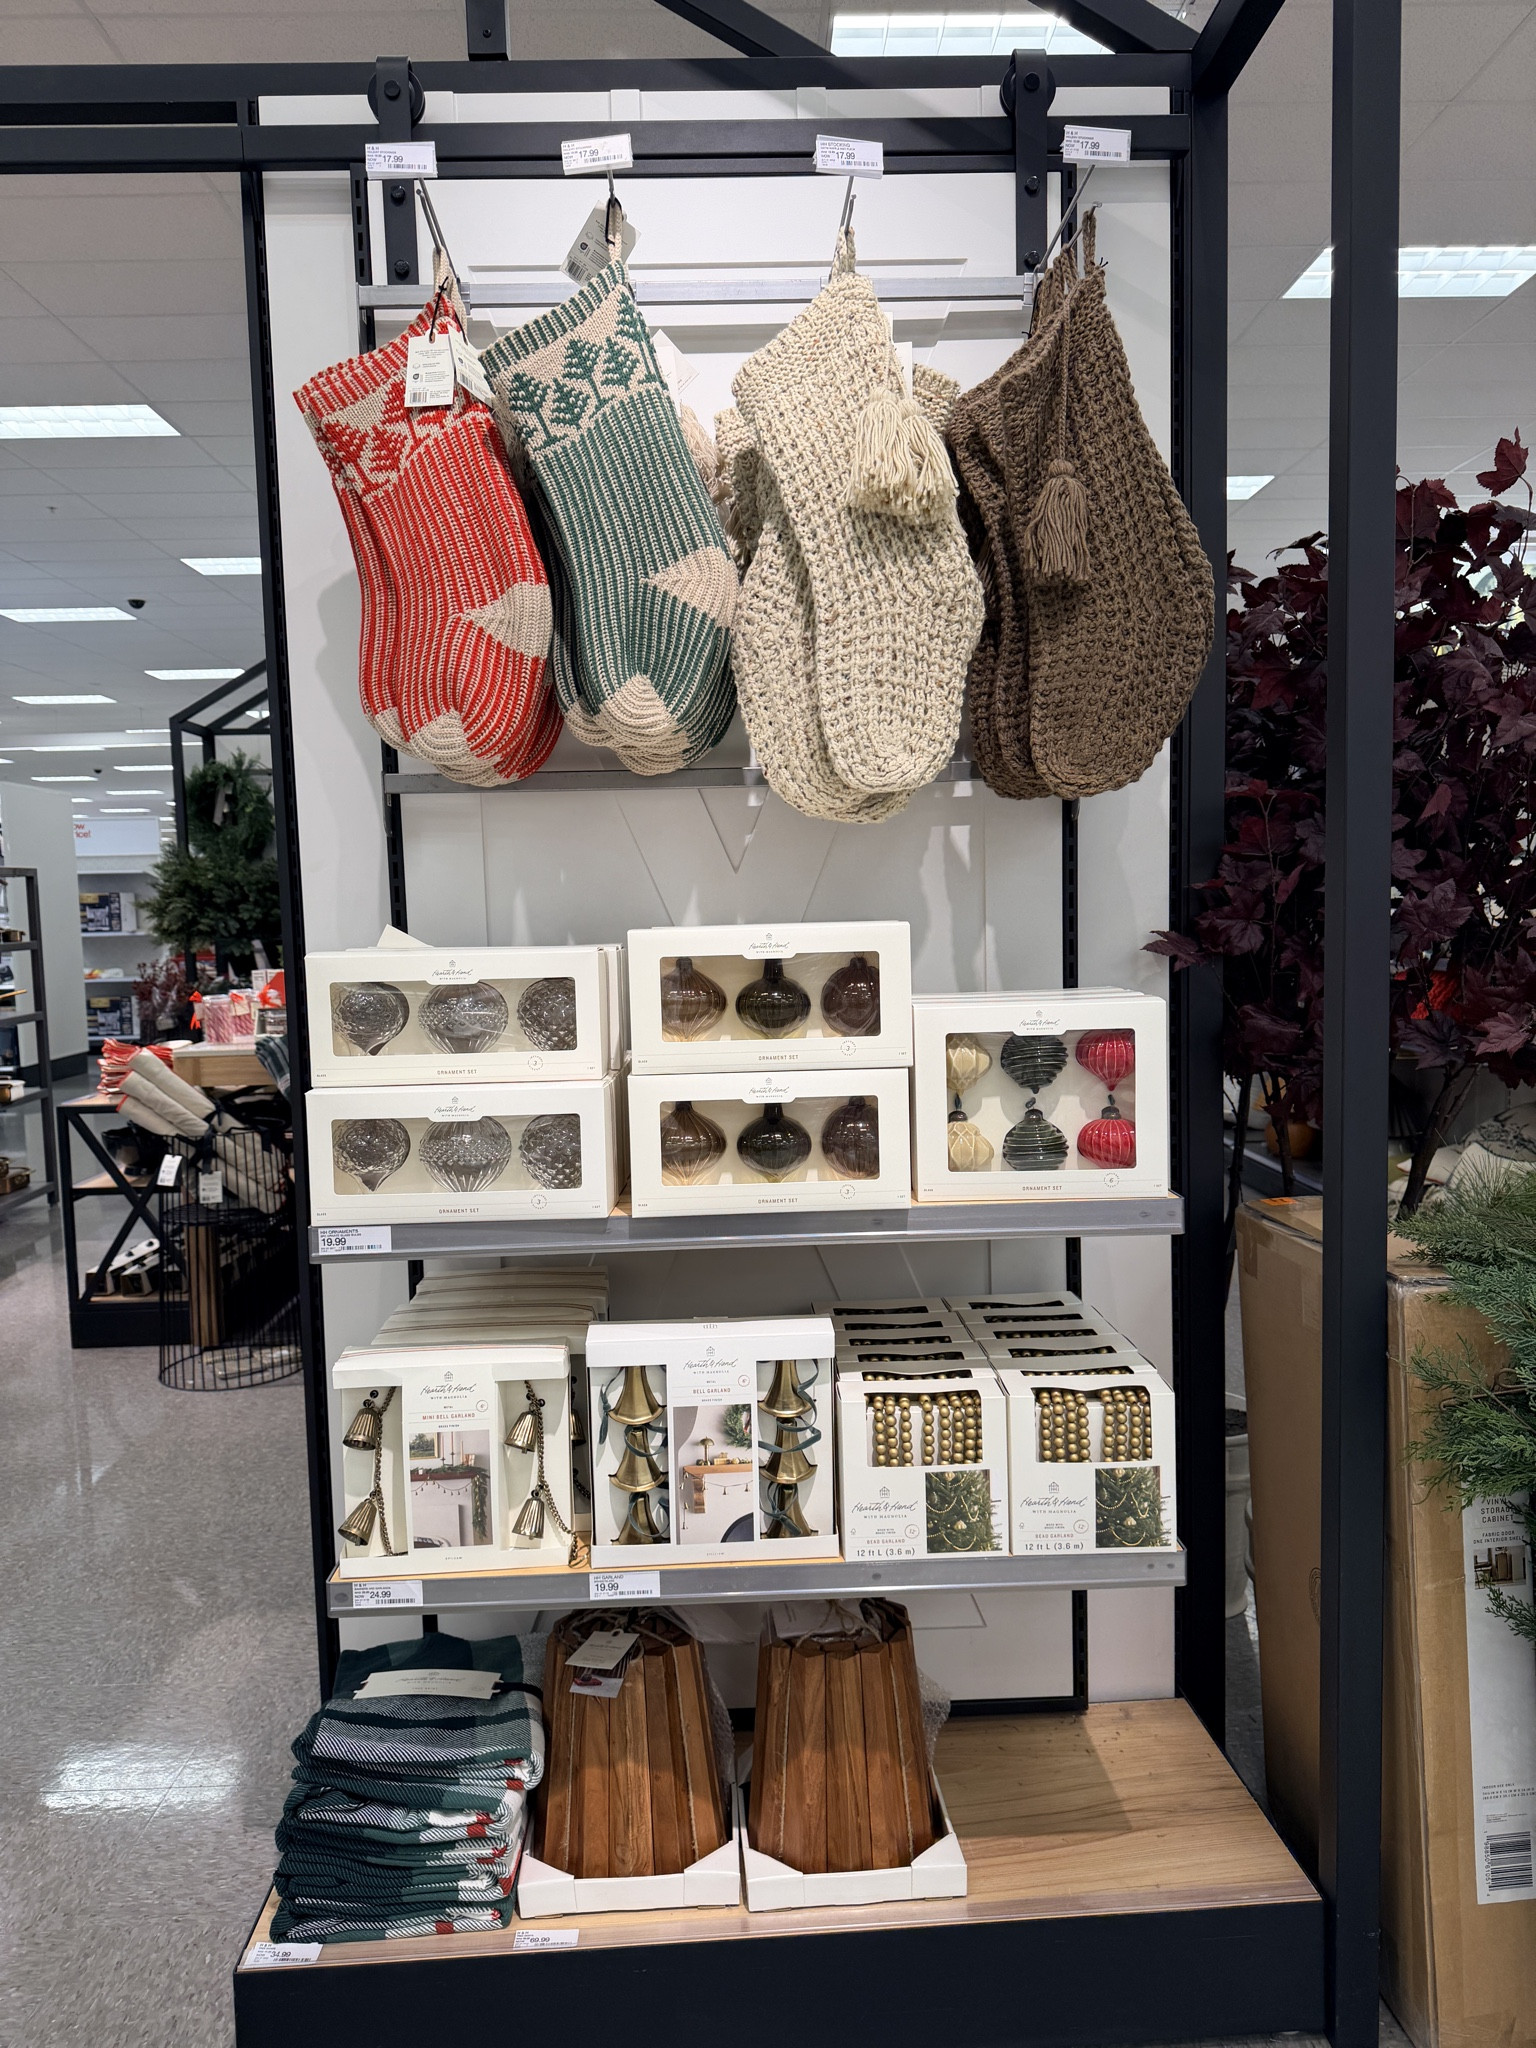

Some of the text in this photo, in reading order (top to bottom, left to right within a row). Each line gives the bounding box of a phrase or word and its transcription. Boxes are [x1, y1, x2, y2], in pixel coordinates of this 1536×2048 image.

[1080, 141, 1100, 150] 17.99
[579, 148, 599, 158] 17.99
[836, 152, 856, 160] 17.99
[322, 1238, 346, 1246] 19.99
[682, 1358, 710, 1370] Hearth
[714, 1358, 738, 1368] Hand
[420, 1383, 448, 1396] Hearth
[452, 1383, 476, 1393] Hand
[1020, 1496, 1054, 1507] Hearth
[1058, 1496, 1088, 1507] Hand
[852, 1500, 884, 1514] Hearth
[889, 1500, 918, 1512] Hand
[1482, 1514, 1514, 1523] CABINET
[1054, 1542, 1071, 1551] (3.6
[1074, 1542, 1084, 1550] m)
[886, 1548, 902, 1557] (3.6
[906, 1548, 915, 1556] m)
[595, 1582, 618, 1591] 19.99
[370, 1590, 391, 1598] 24.99
